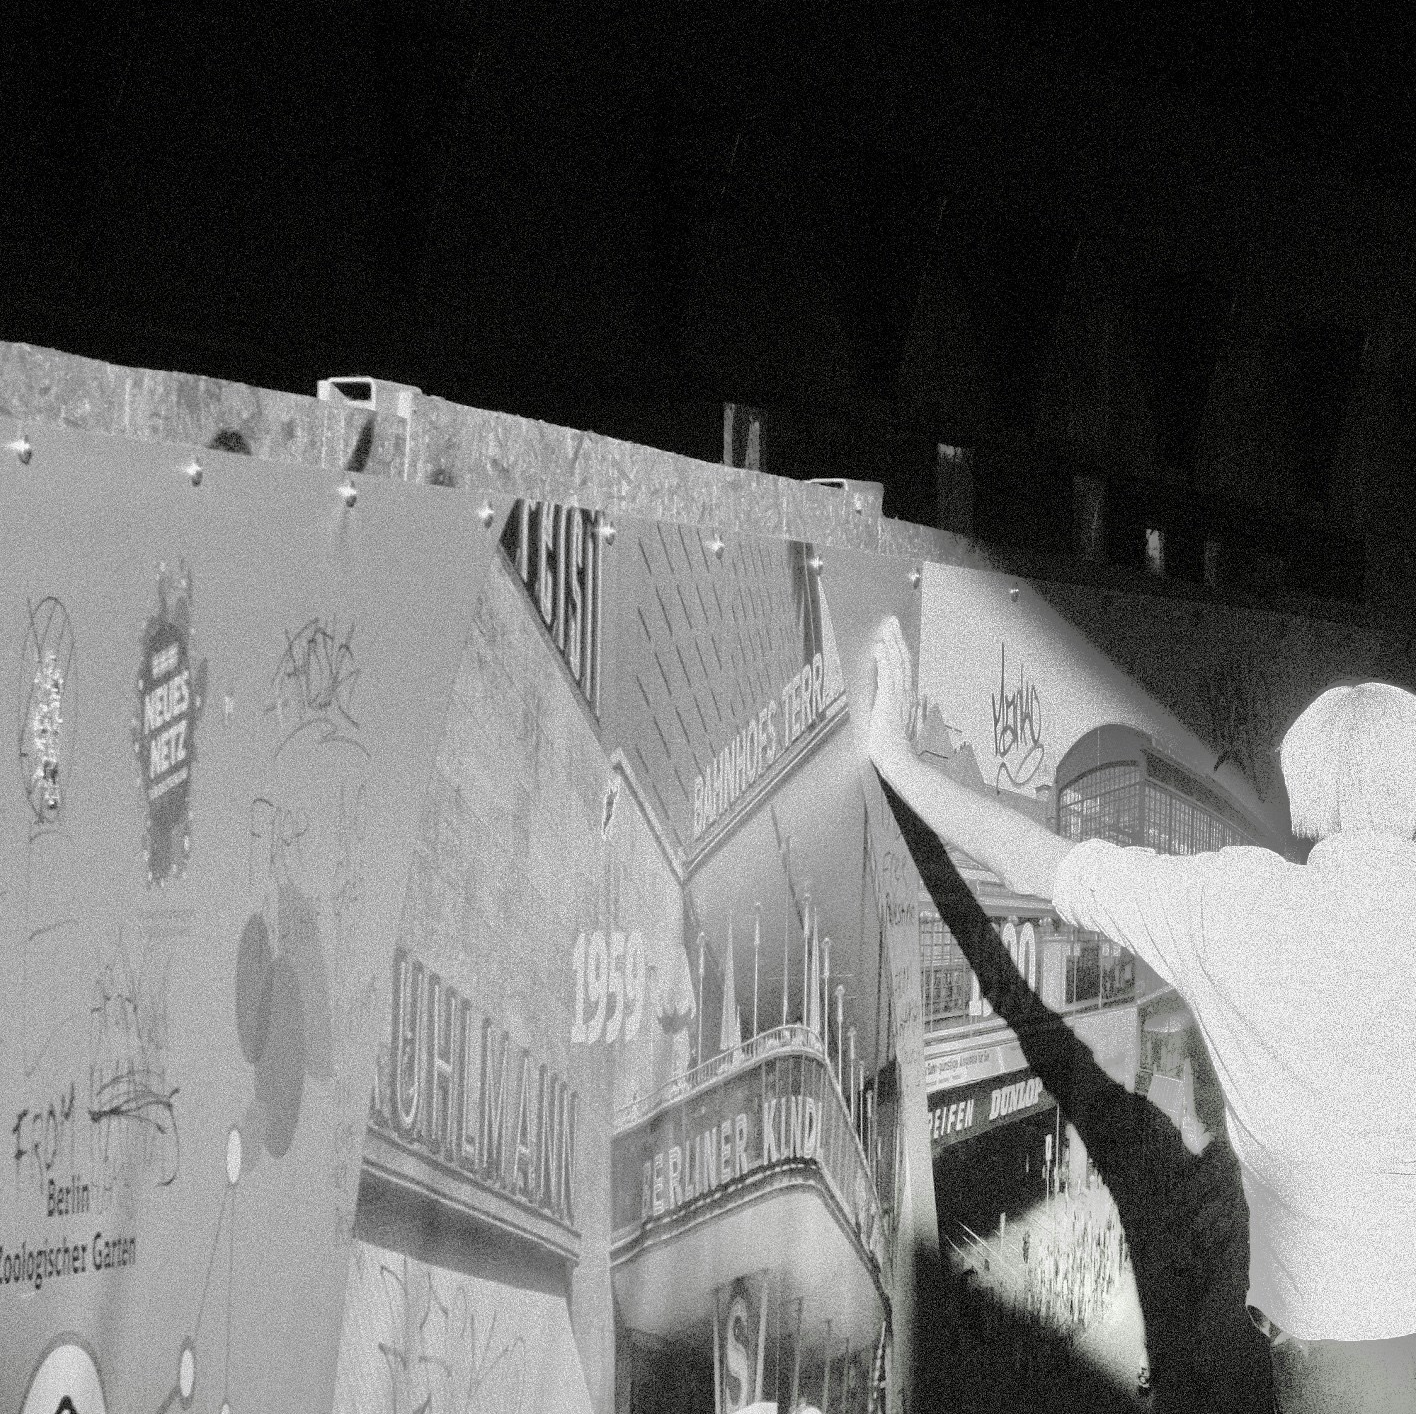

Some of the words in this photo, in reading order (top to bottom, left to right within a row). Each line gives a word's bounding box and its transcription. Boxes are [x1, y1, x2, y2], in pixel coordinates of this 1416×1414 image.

[641, 1112, 749, 1221] BERLINER
[46, 1174, 91, 1217] Berlin
[92, 1231, 137, 1271] Garten
